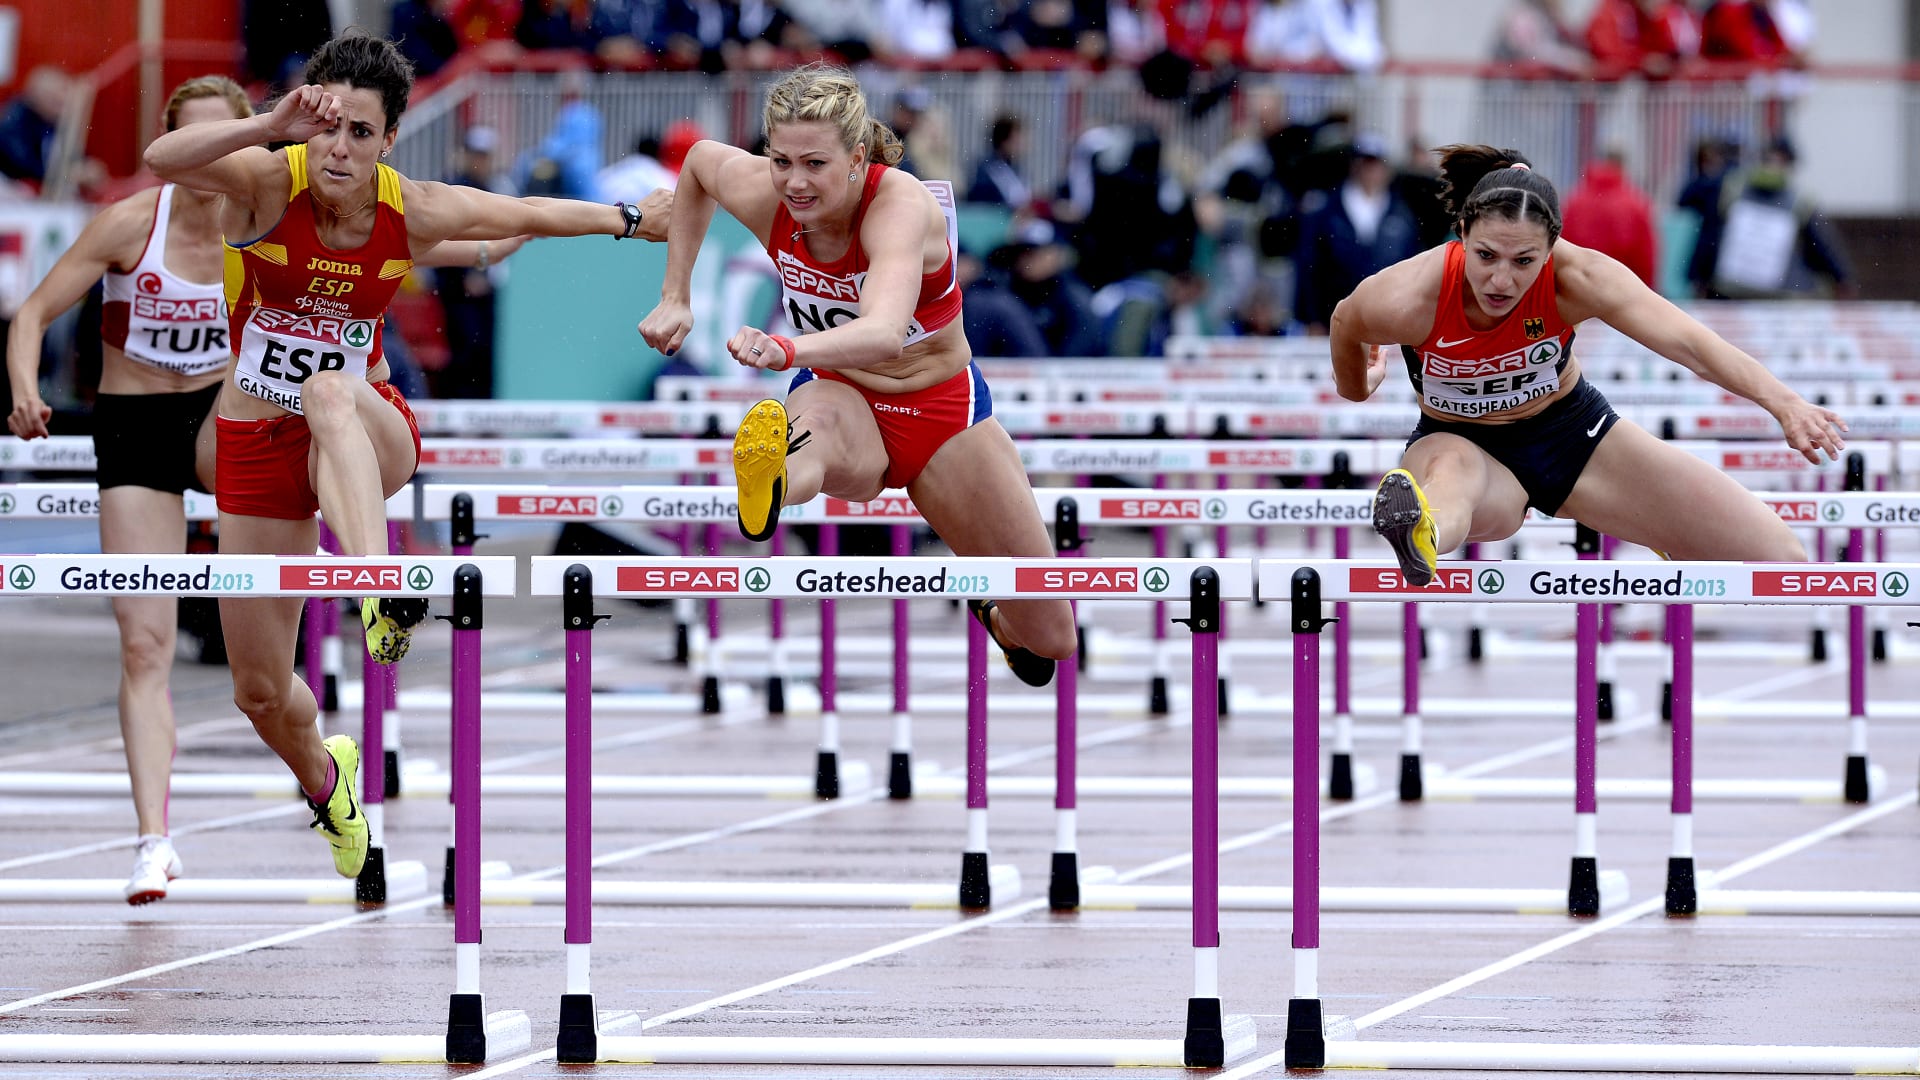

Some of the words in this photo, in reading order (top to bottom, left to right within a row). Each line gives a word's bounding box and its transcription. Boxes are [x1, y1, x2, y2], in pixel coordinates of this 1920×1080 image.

[307, 276, 354, 297] ESP
[784, 265, 858, 300] SPAR
[135, 298, 216, 320] SPAR
[312, 304, 353, 318] Pastora
[315, 297, 349, 311] Divina
[788, 297, 862, 332] NO
[143, 327, 227, 354] TUR
[259, 339, 346, 384] ESP
[1429, 353, 1525, 378] SPAR
[239, 377, 303, 411] GATESHE
[1429, 395, 1520, 415] GATESHEAD
[1523, 383, 1555, 403] 2013
[874, 402, 912, 415] CRAFT
[519, 498, 595, 513] SPAR
[1122, 502, 1199, 516] SPAR
[308, 570, 399, 586] SPAR
[645, 571, 737, 588] SPAR
[1043, 572, 1136, 588] SPAR
[1781, 575, 1874, 592] SPAR
